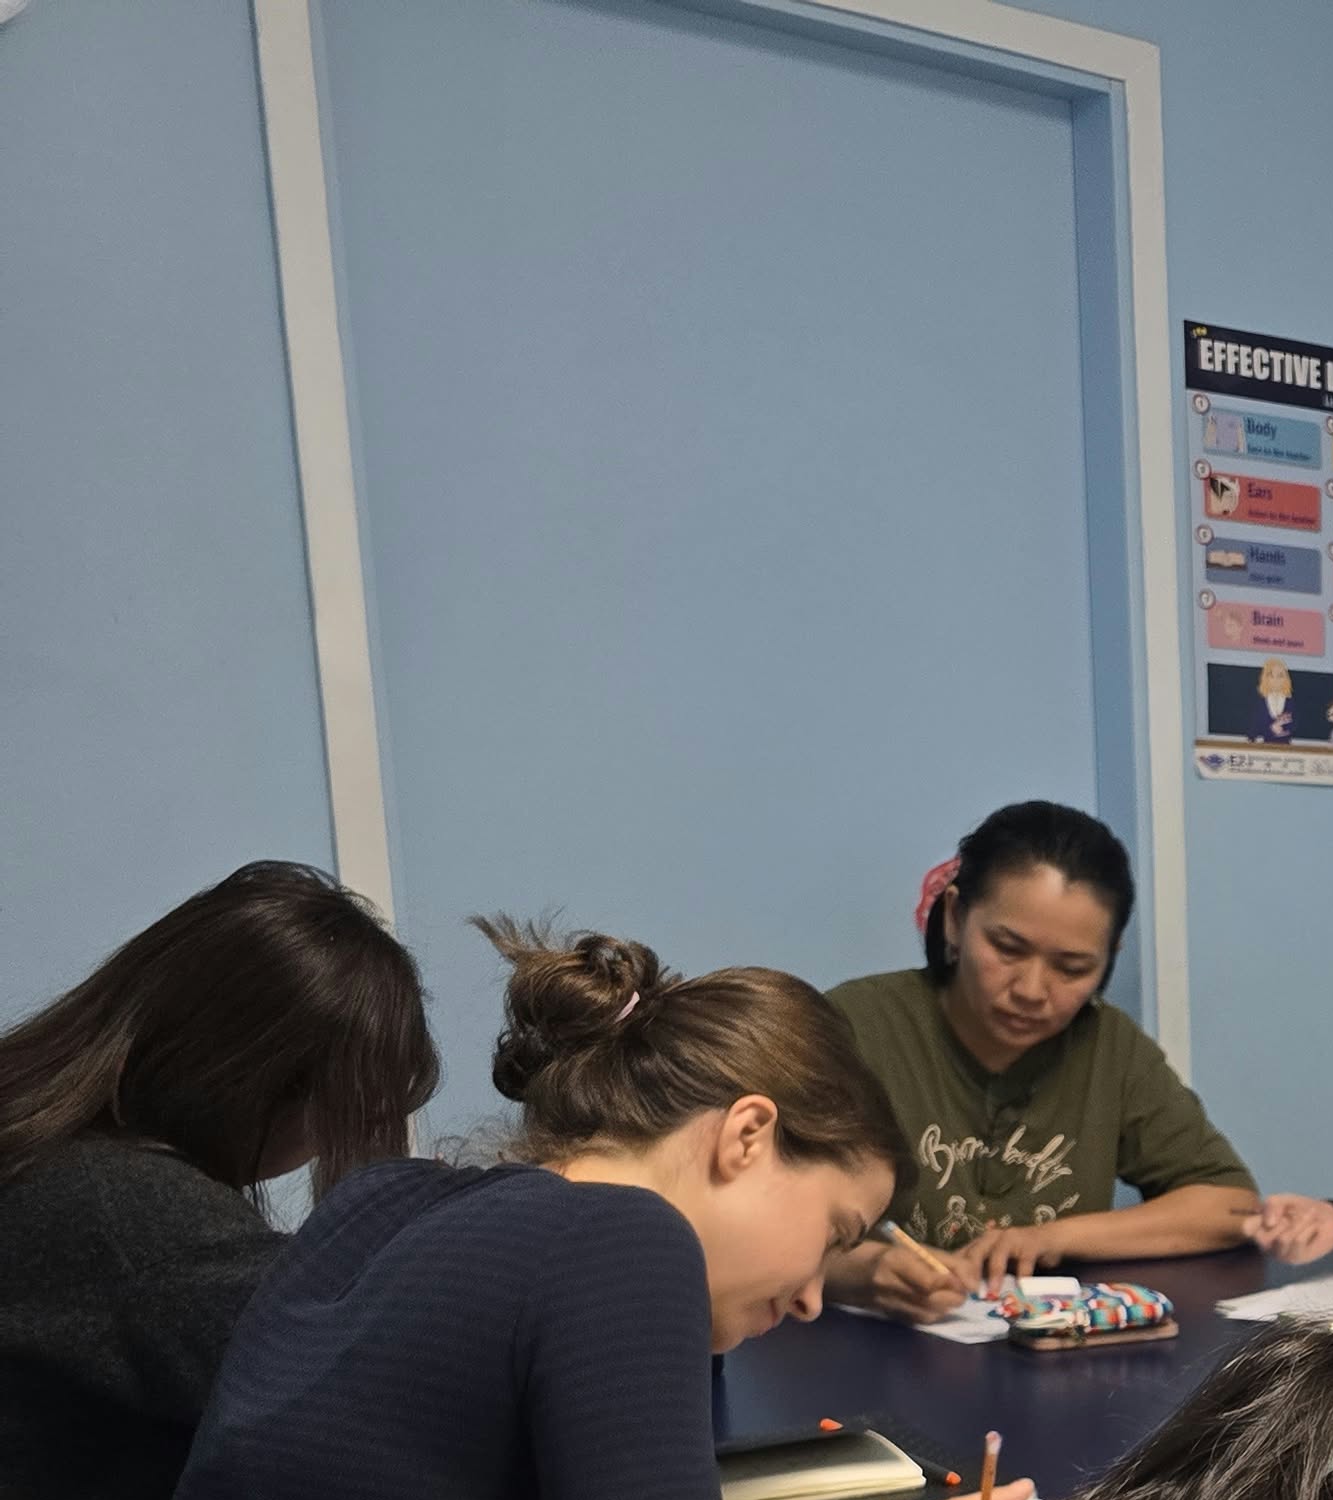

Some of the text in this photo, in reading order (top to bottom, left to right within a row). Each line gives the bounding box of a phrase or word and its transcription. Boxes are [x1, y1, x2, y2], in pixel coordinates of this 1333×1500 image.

[1198, 338, 1321, 390] EFFECTIVE
[1246, 418, 1278, 440] Body
[1252, 610, 1285, 627] Brain
